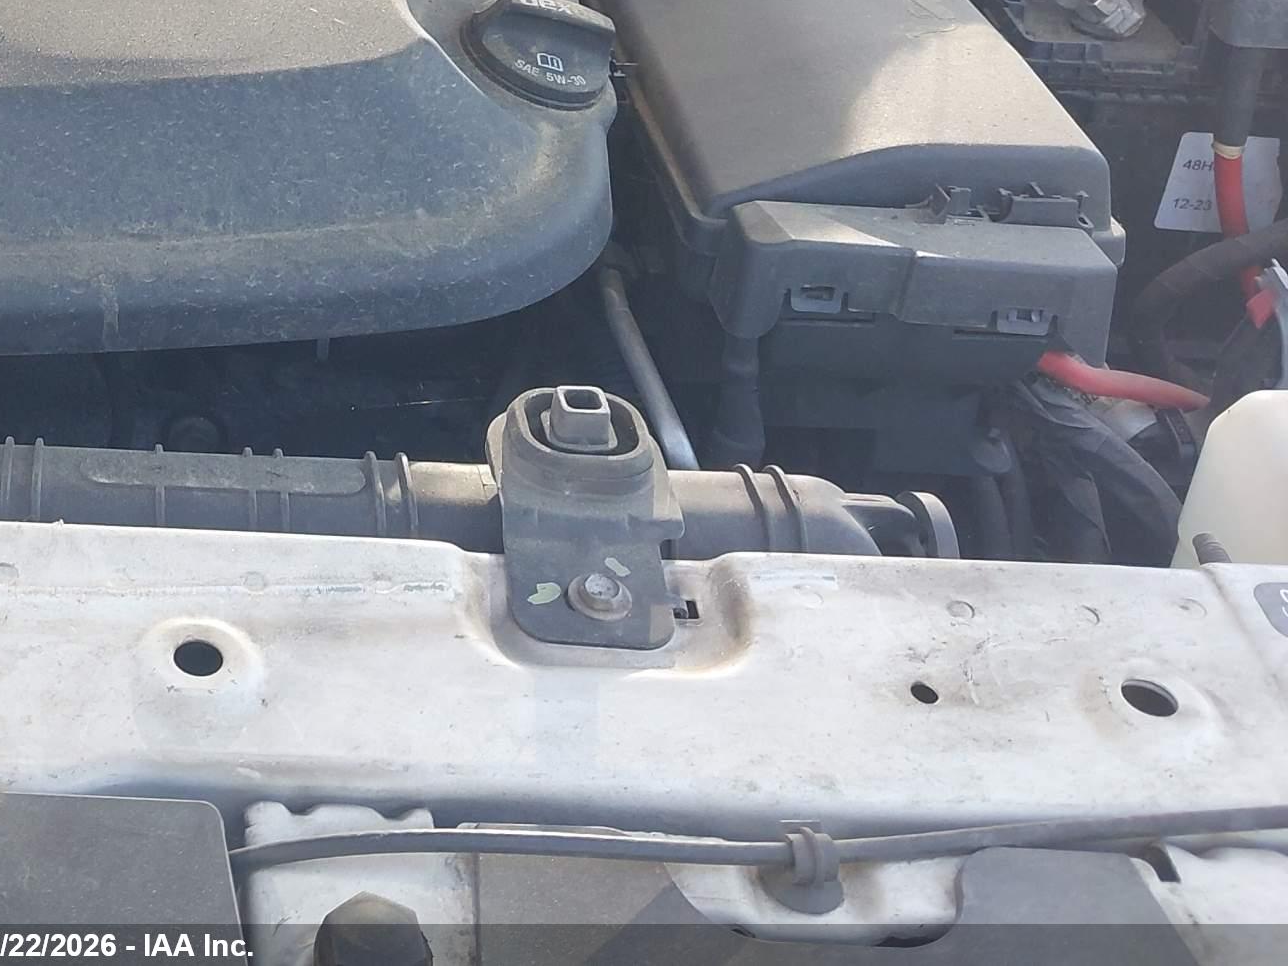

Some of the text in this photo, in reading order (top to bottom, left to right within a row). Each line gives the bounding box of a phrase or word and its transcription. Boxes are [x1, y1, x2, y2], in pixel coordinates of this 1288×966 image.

[514, 59, 587, 87] SAE 5W-30
[1182, 159, 1214, 172] 48H
[1173, 198, 1213, 212] 12-23
